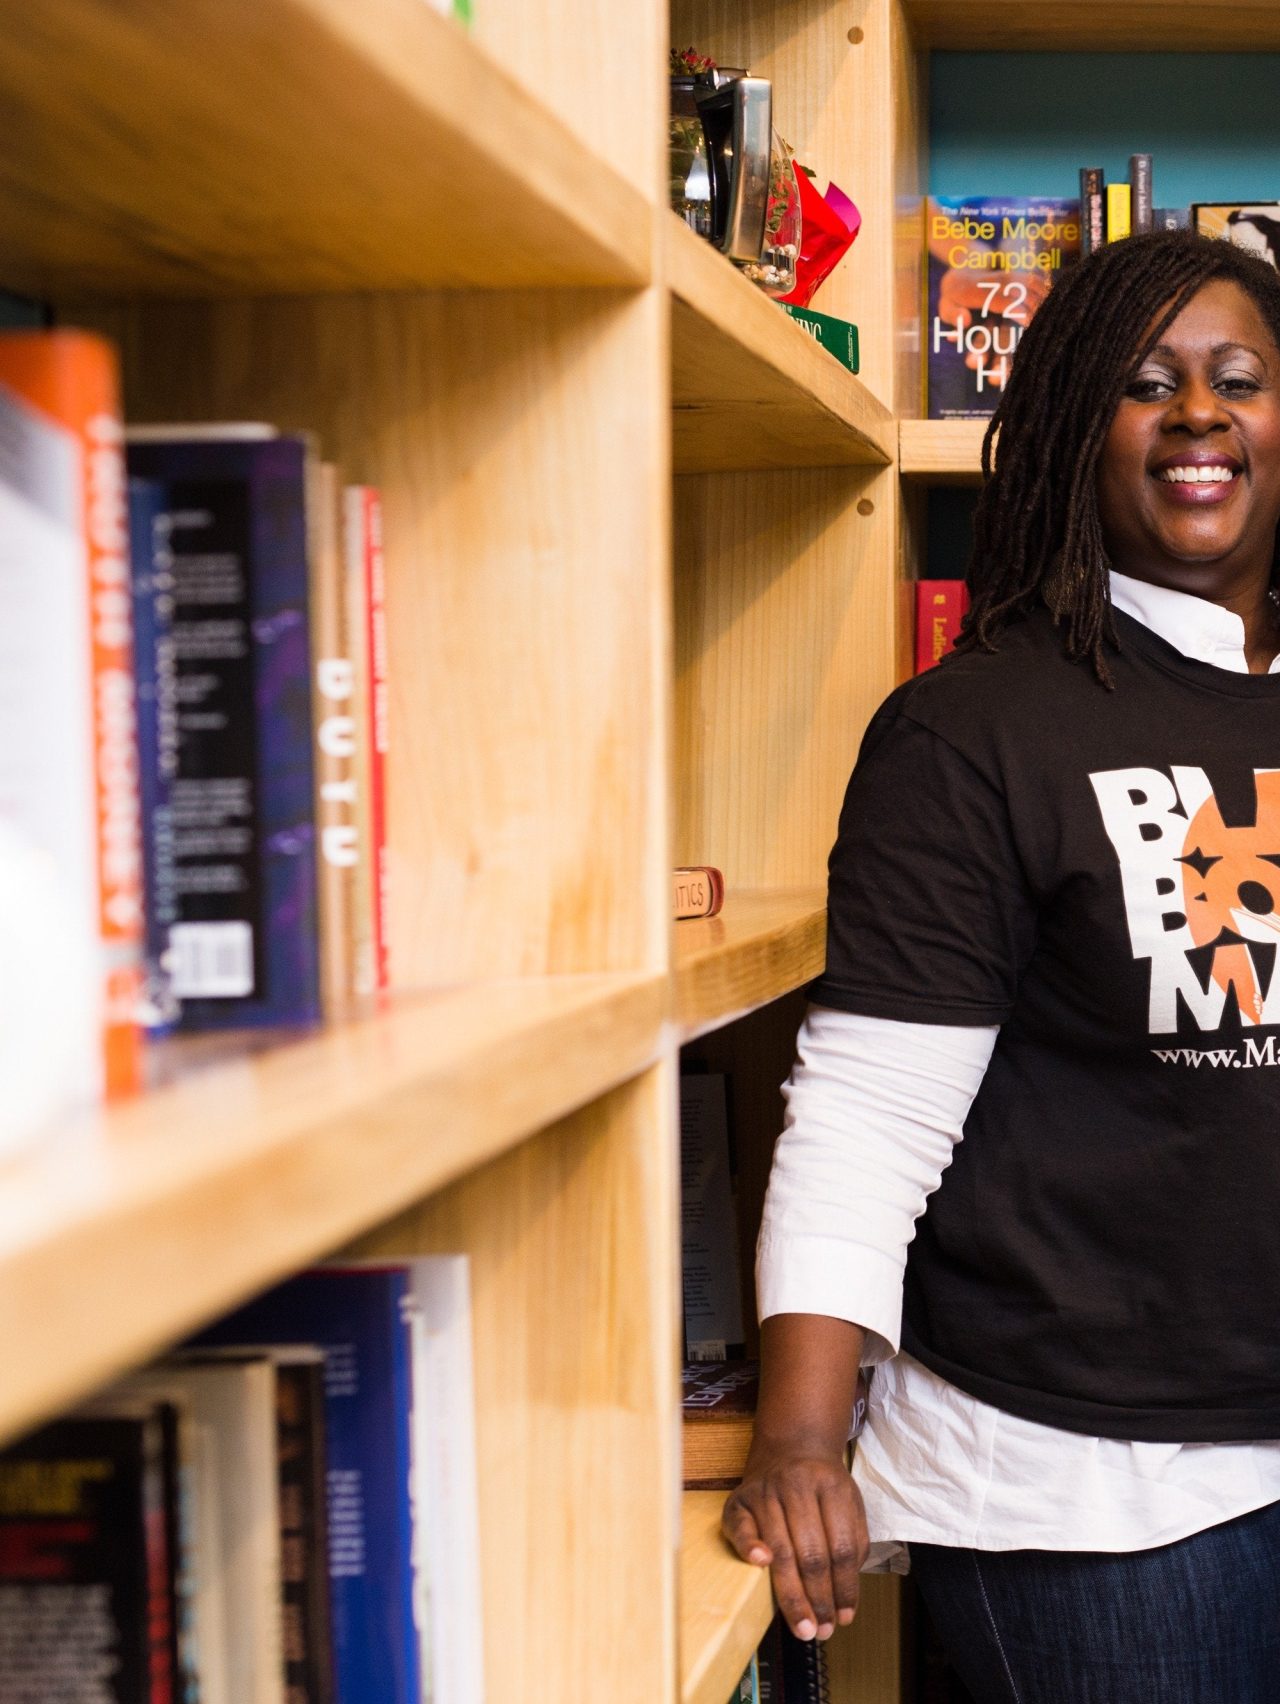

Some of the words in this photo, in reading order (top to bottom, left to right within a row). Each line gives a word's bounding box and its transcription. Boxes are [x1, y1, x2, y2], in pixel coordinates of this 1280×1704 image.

[960, 207, 979, 215] New
[982, 207, 999, 215] York
[1001, 207, 1026, 216] Times
[931, 216, 995, 241] Bebe
[1002, 216, 1079, 242] Moore
[947, 244, 1061, 273] Campbell
[976, 281, 1028, 319] 72
